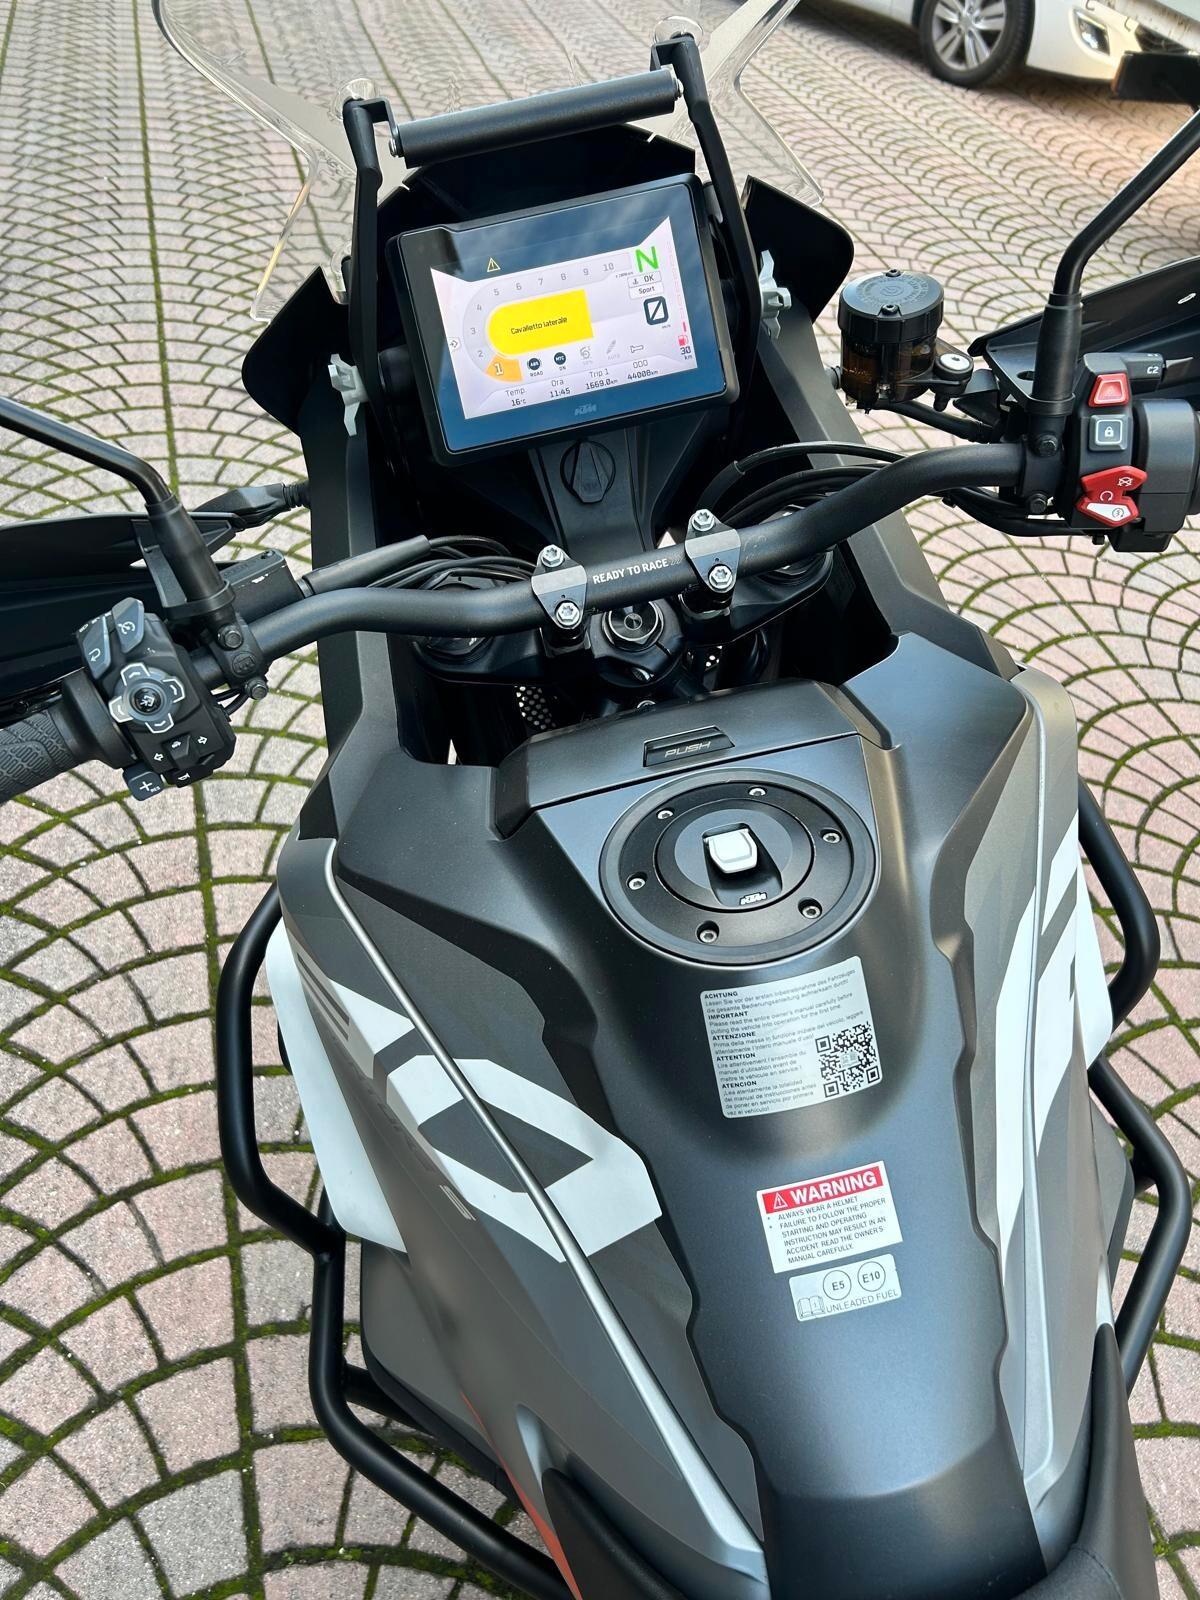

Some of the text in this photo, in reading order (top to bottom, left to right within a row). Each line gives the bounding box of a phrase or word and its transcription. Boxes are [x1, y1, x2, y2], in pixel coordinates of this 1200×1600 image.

[636, 246, 659, 272] N
[602, 262, 615, 272] 10
[638, 286, 655, 295] Sport
[511, 316, 568, 334] Cavalletto laterale
[680, 346, 692, 355] 30
[494, 362, 504, 376] 1
[1147, 366, 1159, 374] C2
[550, 387, 570, 398] 11:45
[593, 559, 669, 584] READY TO RACE
[665, 741, 711, 758] PUSH
[740, 892, 768, 906] KTM
[704, 991, 738, 999] ACHTUNG
[708, 1011, 748, 1020] IMPORTANT
[713, 1031, 756, 1040] ATTENZIONE
[716, 1052, 756, 1061] ATTENTION
[790, 1170, 877, 1204] WARNING
[778, 1210, 804, 1220] ALWAYS
[805, 1205, 825, 1214] WEAR
[833, 1195, 858, 1207] HELMET
[780, 1218, 806, 1228] FAILURE
[818, 1209, 845, 1220] FOLLOW
[847, 1204, 859, 1213] THE
[860, 1197, 886, 1209] PROPER
[782, 1212, 867, 1238] STARTING AND OPERATING
[784, 1232, 828, 1246] INSTRUCTION
[829, 1227, 842, 1236] MAY
[844, 1221, 867, 1232] RESULT
[821, 1238, 839, 1247] READ
[840, 1234, 853, 1242] THE
[788, 1252, 816, 1264] MANUAL
[862, 1270, 881, 1284] E10
[832, 1281, 845, 1291] E5
[826, 1289, 898, 1313] UNLEADED FUEL
